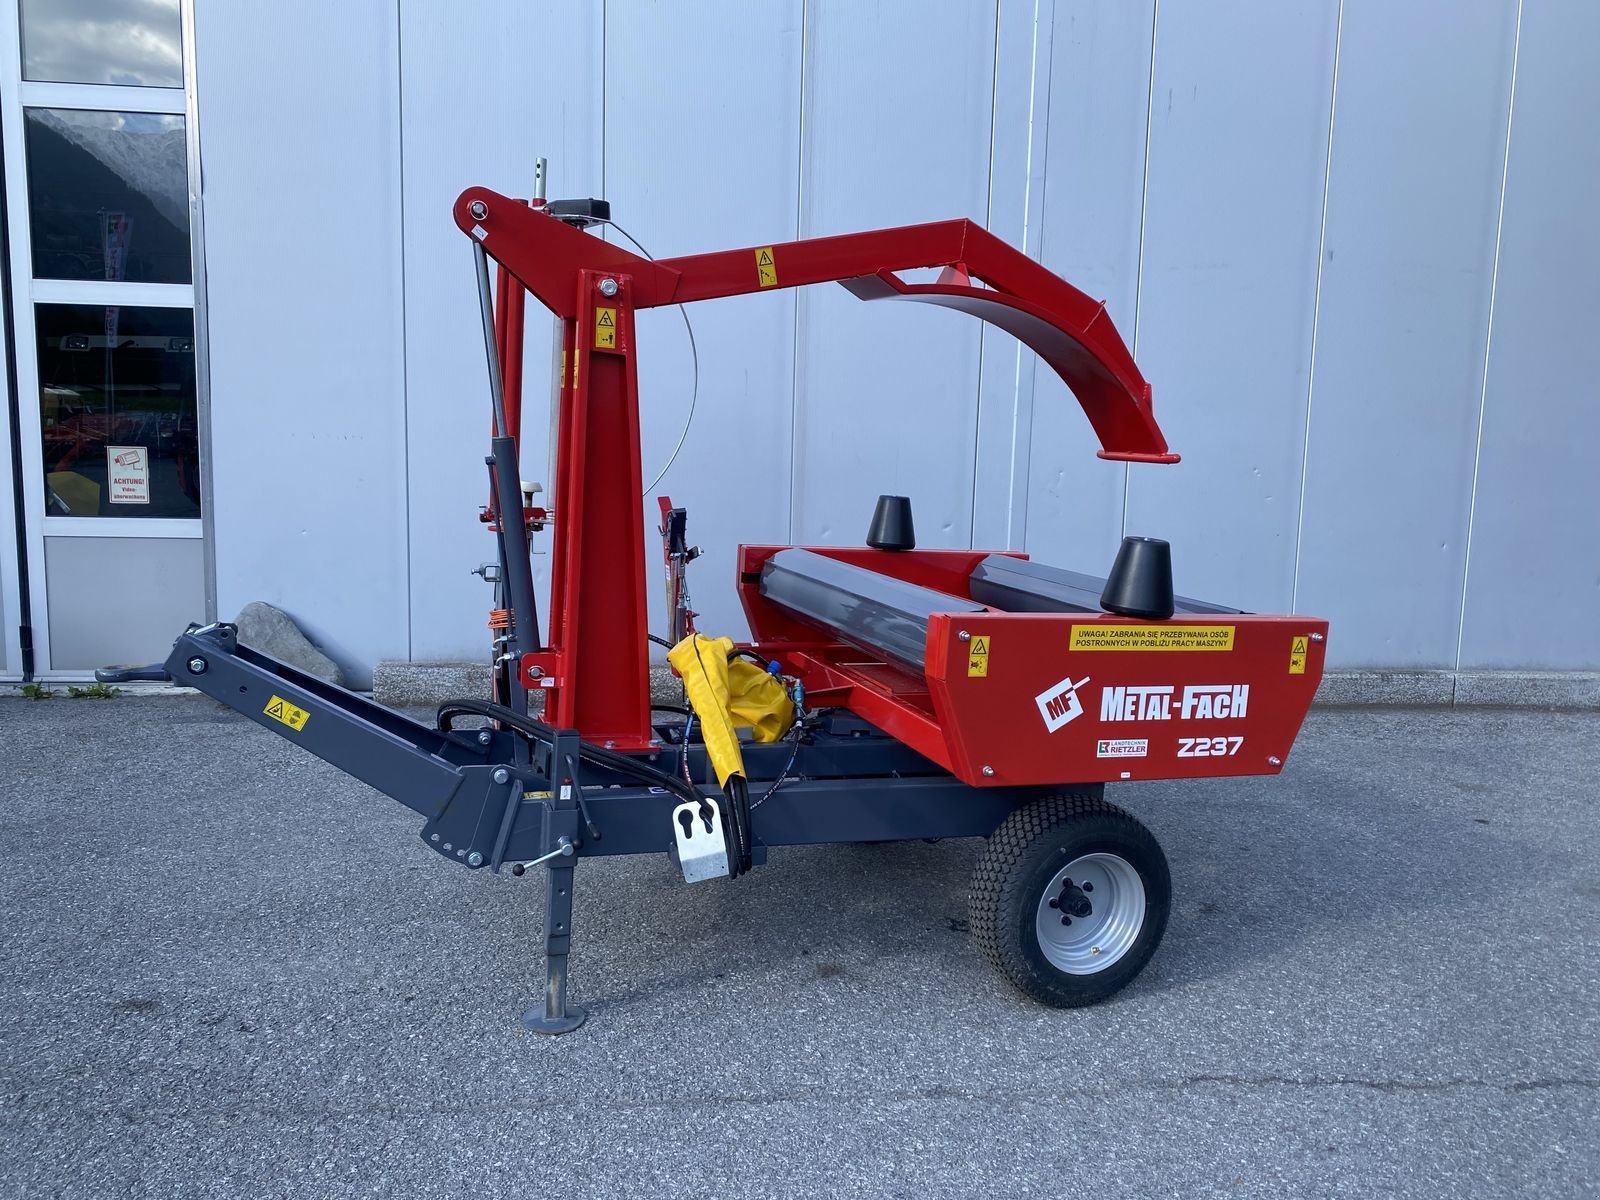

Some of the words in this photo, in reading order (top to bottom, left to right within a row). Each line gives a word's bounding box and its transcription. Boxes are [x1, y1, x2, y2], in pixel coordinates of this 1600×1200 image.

[1078, 630, 1109, 638] UWAGA!
[1109, 630, 1146, 638] ZABRANIA
[1146, 630, 1159, 639] SIĘ
[1159, 630, 1209, 638] PRZEBYWANIA
[1209, 630, 1229, 638] OSÓB
[1075, 639, 1131, 647] POSTRONNYCH
[1140, 639, 1170, 647] POBLIŻU
[1044, 692, 1073, 721] MF
[1176, 736, 1244, 758] Z237
